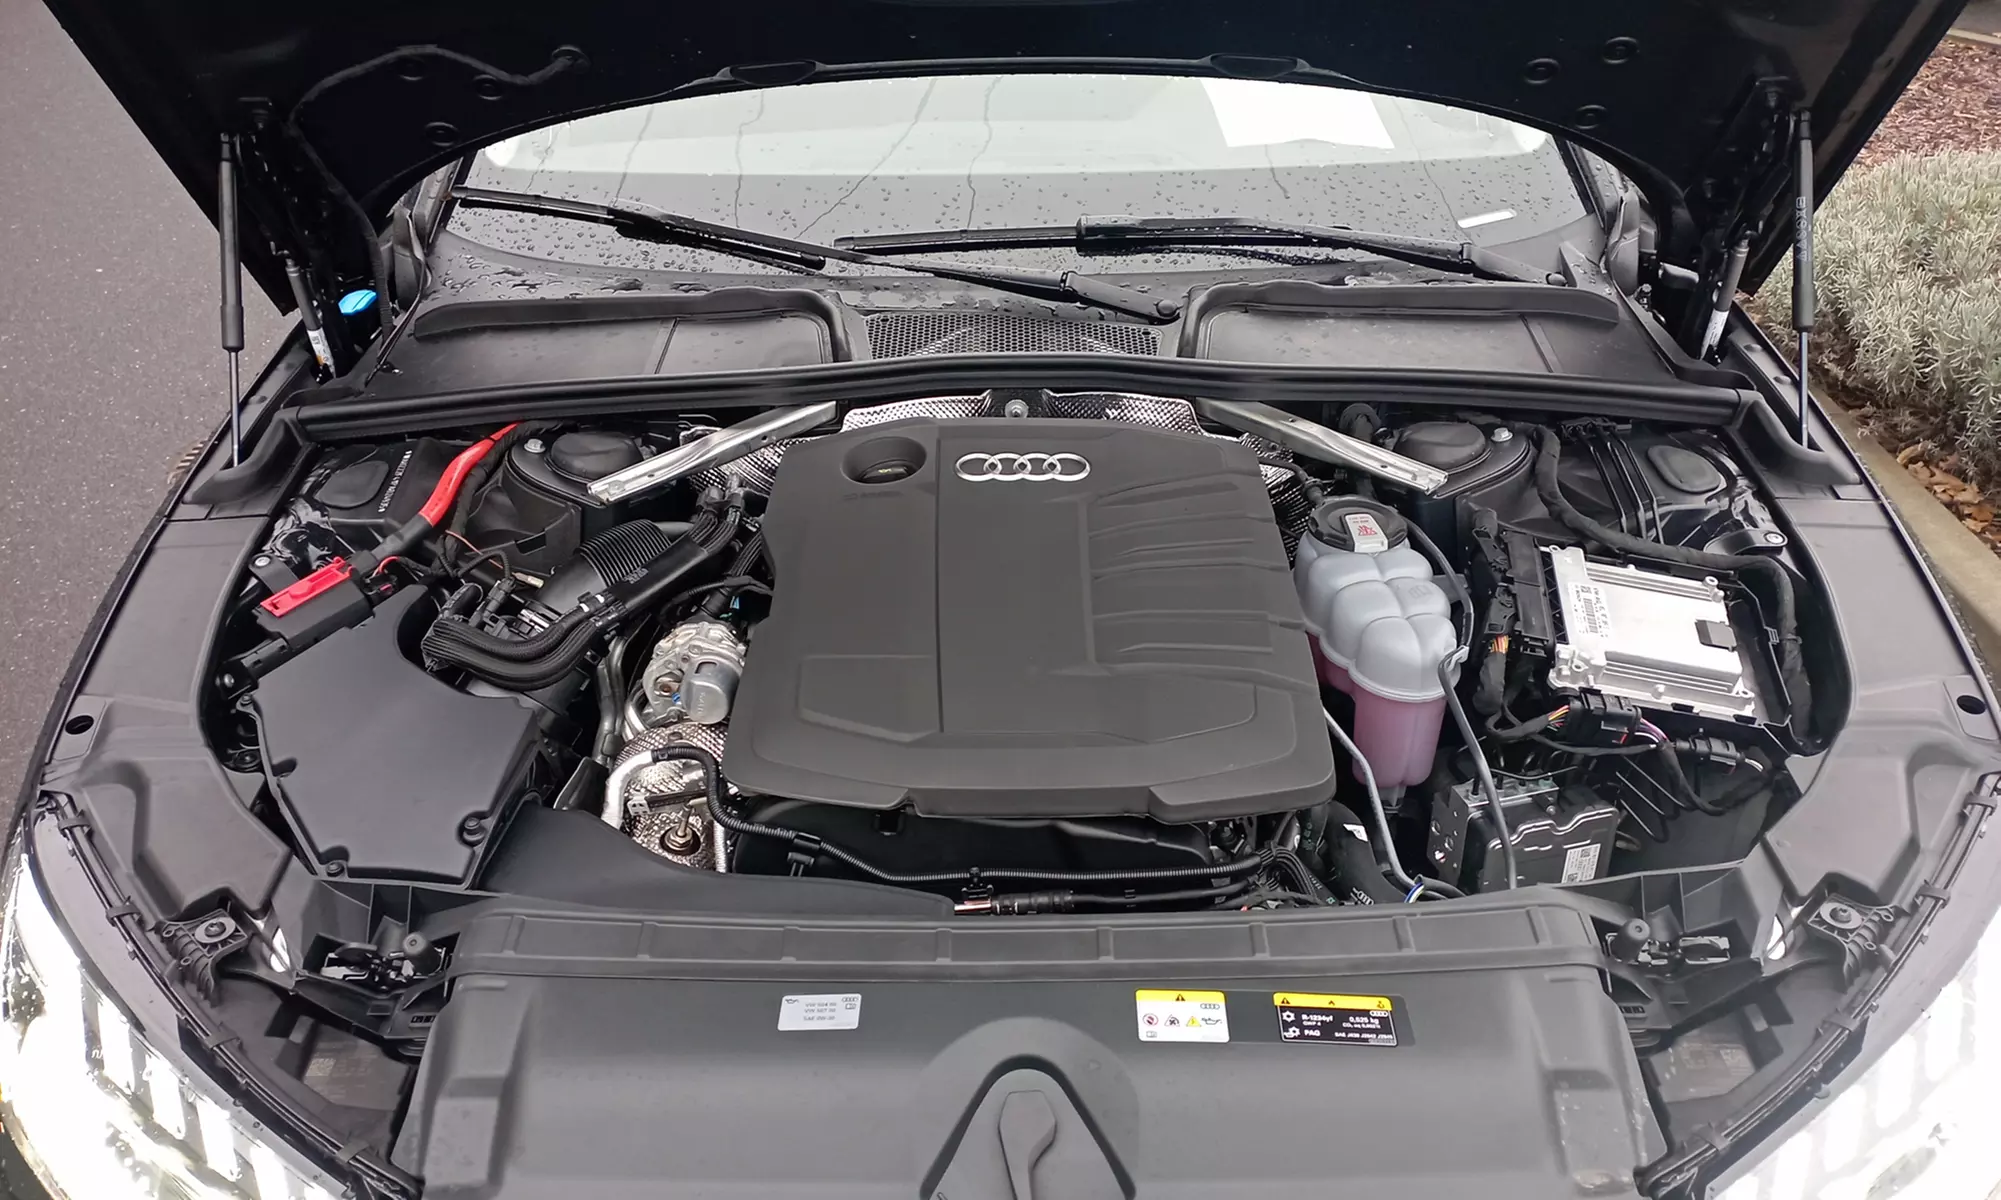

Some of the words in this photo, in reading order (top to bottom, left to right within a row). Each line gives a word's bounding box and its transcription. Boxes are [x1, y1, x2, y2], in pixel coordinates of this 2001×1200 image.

[1301, 1014, 1333, 1022] R-1234yf
[1370, 1017, 1380, 1025] kg
[1304, 1029, 1321, 1037] PAG
